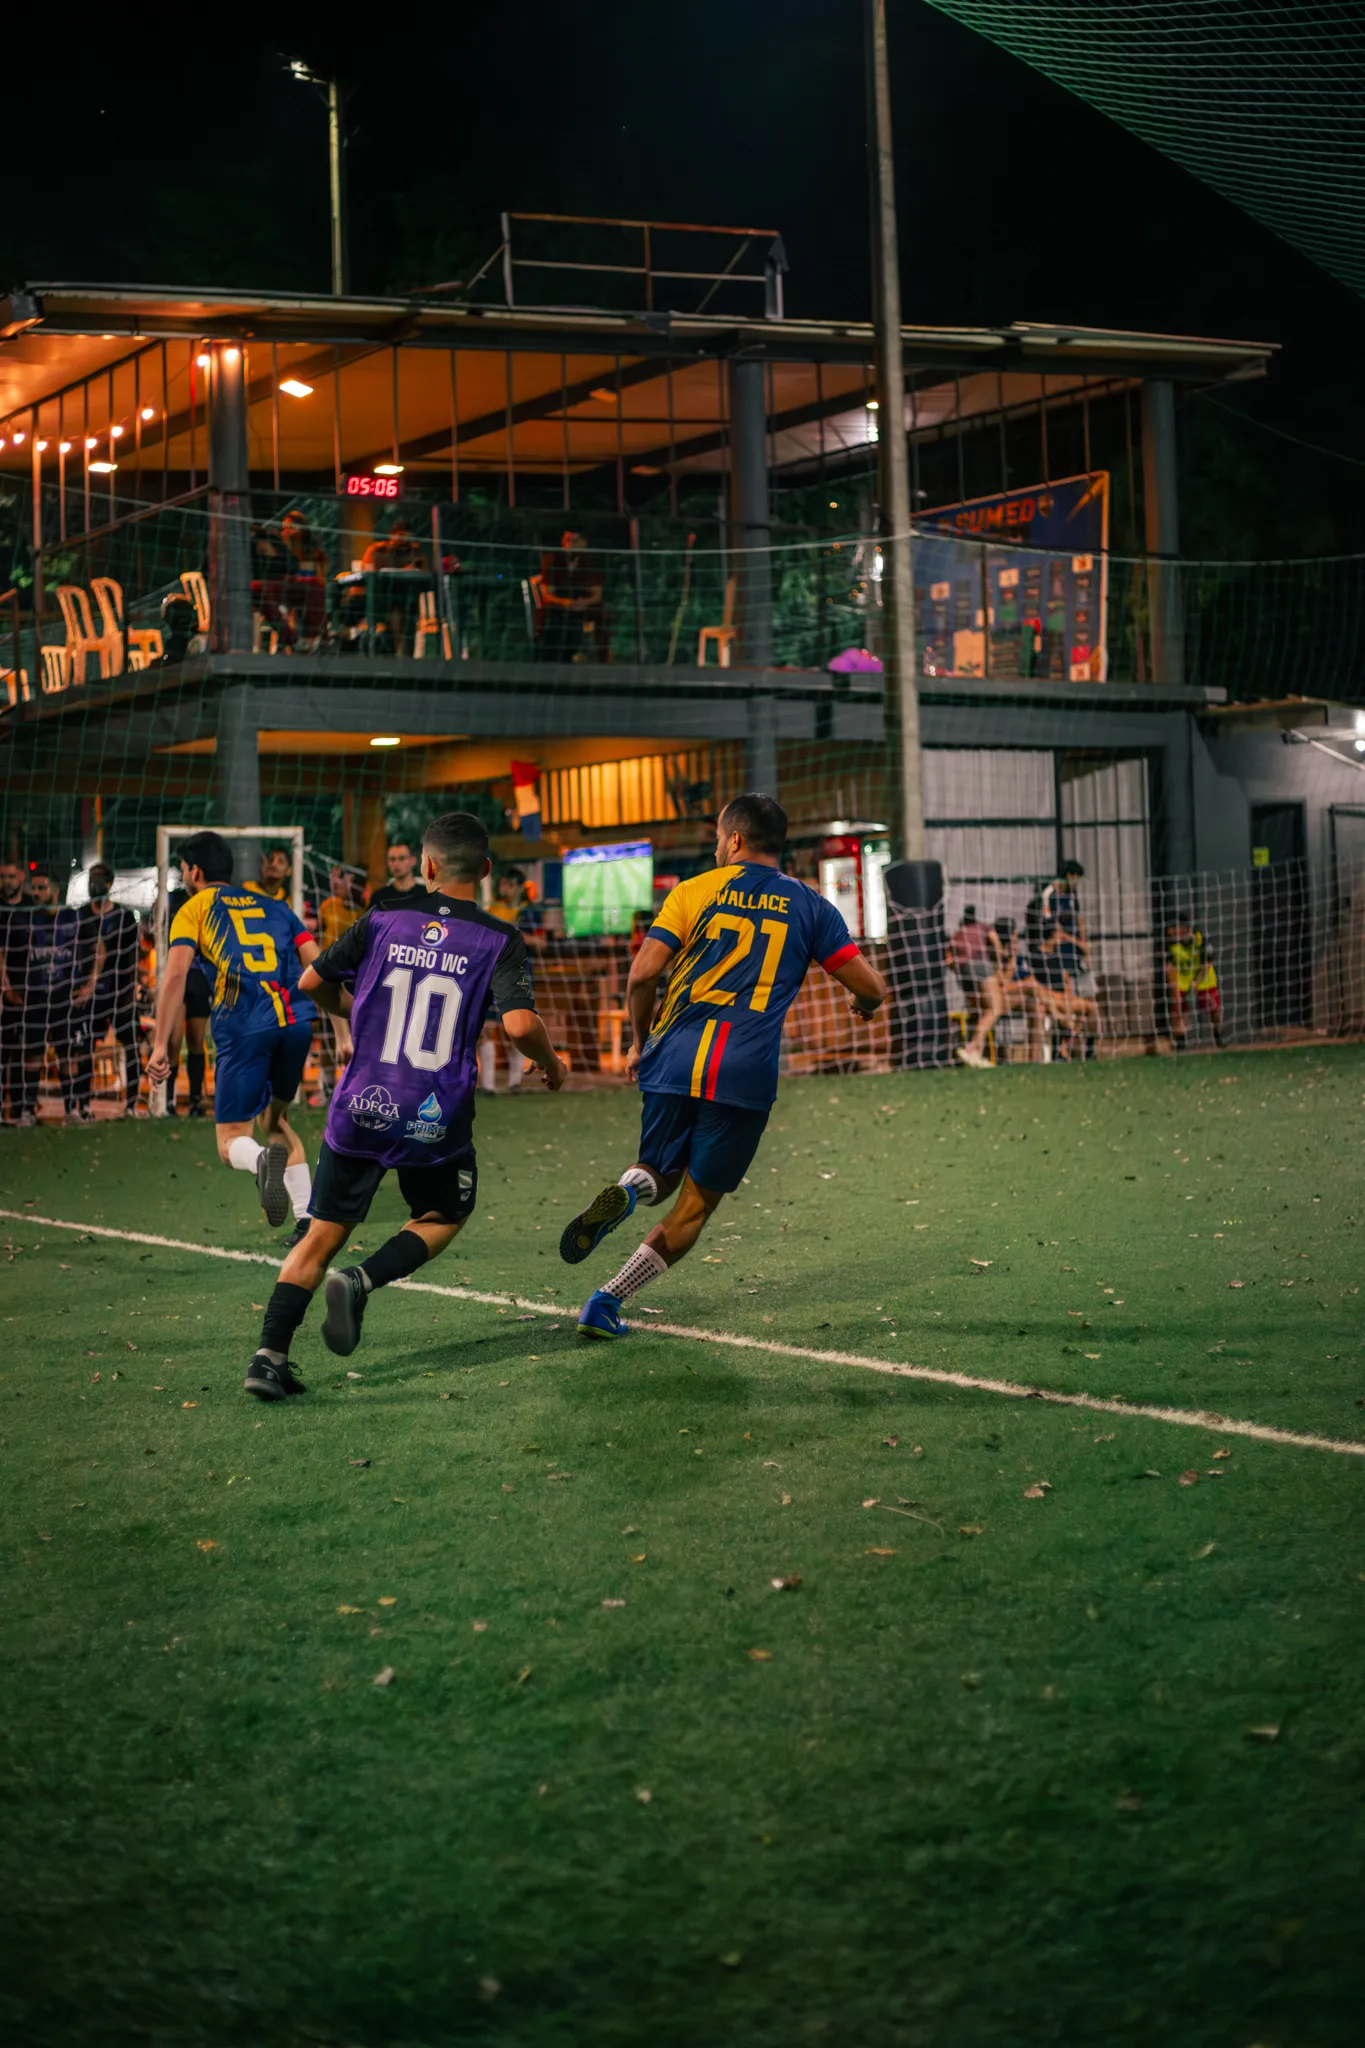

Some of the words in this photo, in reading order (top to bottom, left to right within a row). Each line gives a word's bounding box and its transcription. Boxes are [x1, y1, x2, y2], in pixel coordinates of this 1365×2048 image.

[347, 476, 398, 497] 05:06
[716, 890, 790, 914] WALLACE
[228, 908, 278, 973] 5
[388, 943, 437, 969] PEDRO
[441, 952, 469, 975] WC
[690, 912, 789, 1013] 21
[380, 967, 463, 1073] 10
[348, 1096, 400, 1119] ADEGA
[406, 1120, 447, 1135] PRIME
